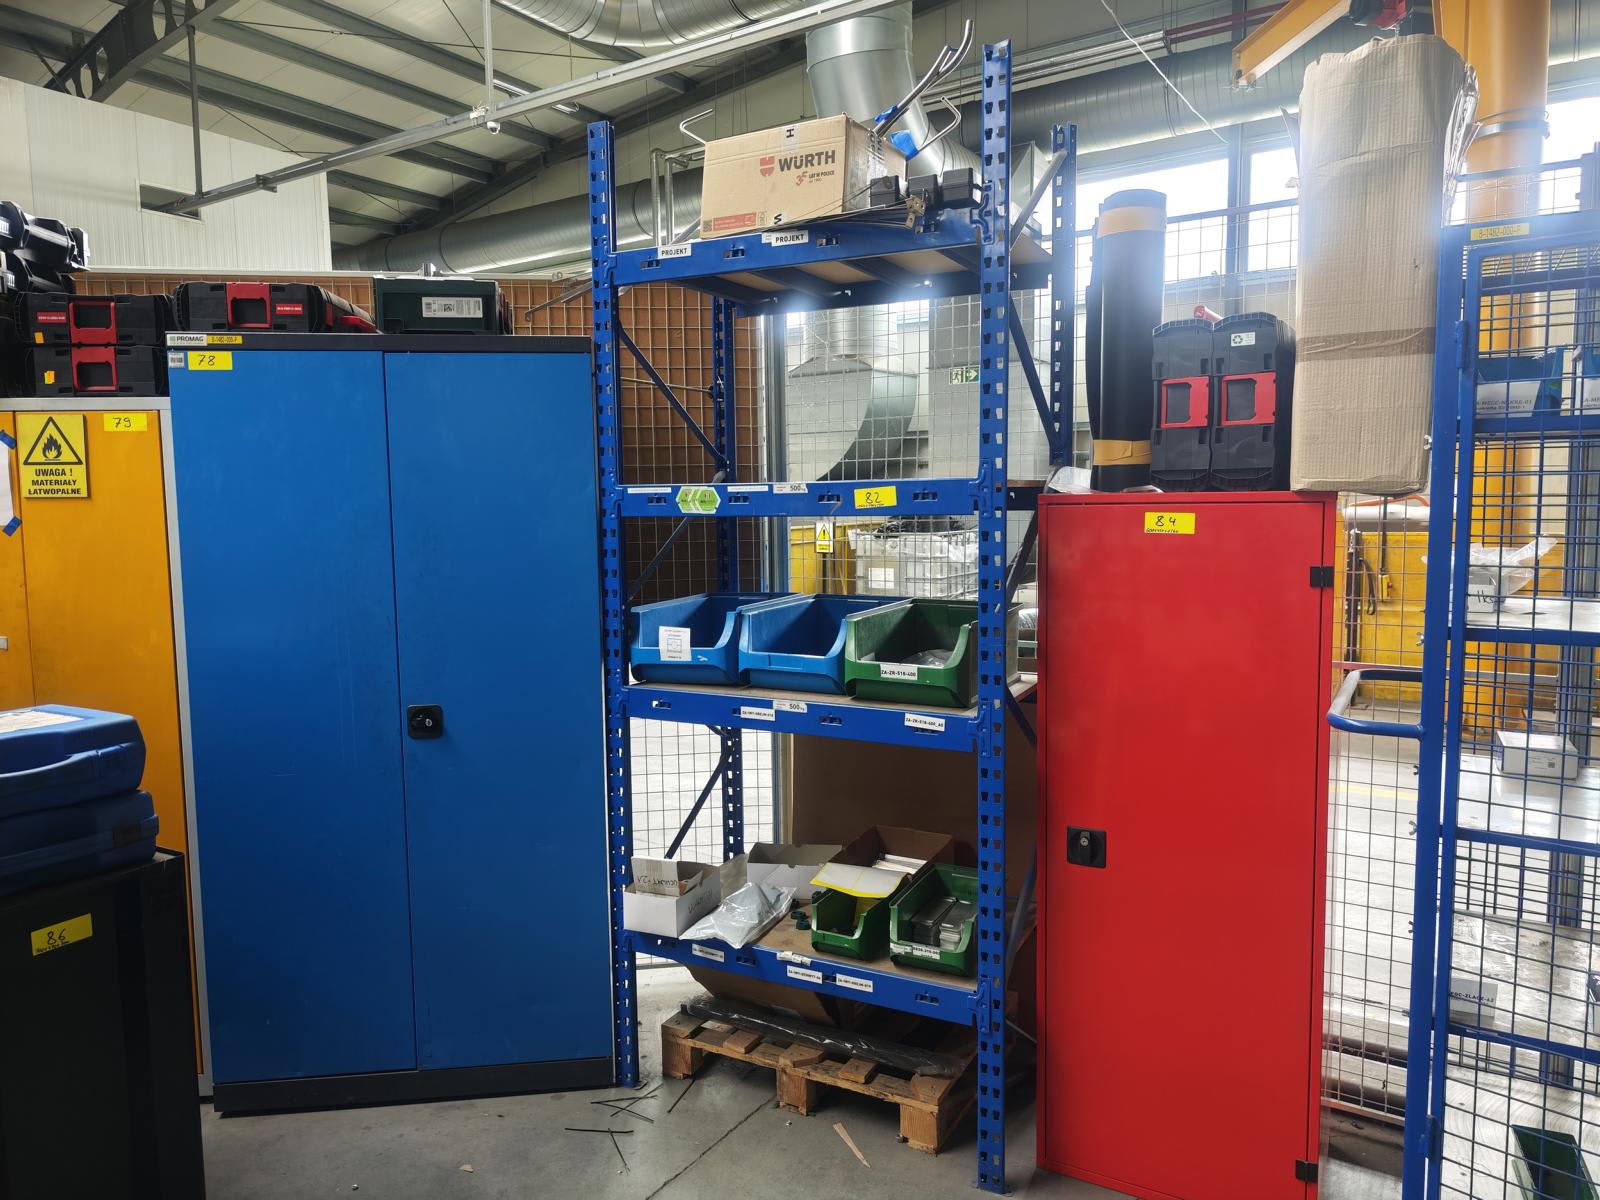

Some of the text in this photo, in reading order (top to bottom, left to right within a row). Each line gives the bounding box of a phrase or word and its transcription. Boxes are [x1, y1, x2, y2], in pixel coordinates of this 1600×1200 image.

[778, 149, 836, 173] WÜRTH
[775, 234, 804, 244] PROJEKT
[661, 248, 688, 257] PROJEKT
[197, 354, 216, 366] 78
[112, 417, 132, 428] 79
[35, 468, 66, 477] UWAGA
[866, 491, 881, 504] 82
[1156, 515, 1176, 526] 84
[48, 928, 66, 946] 86
